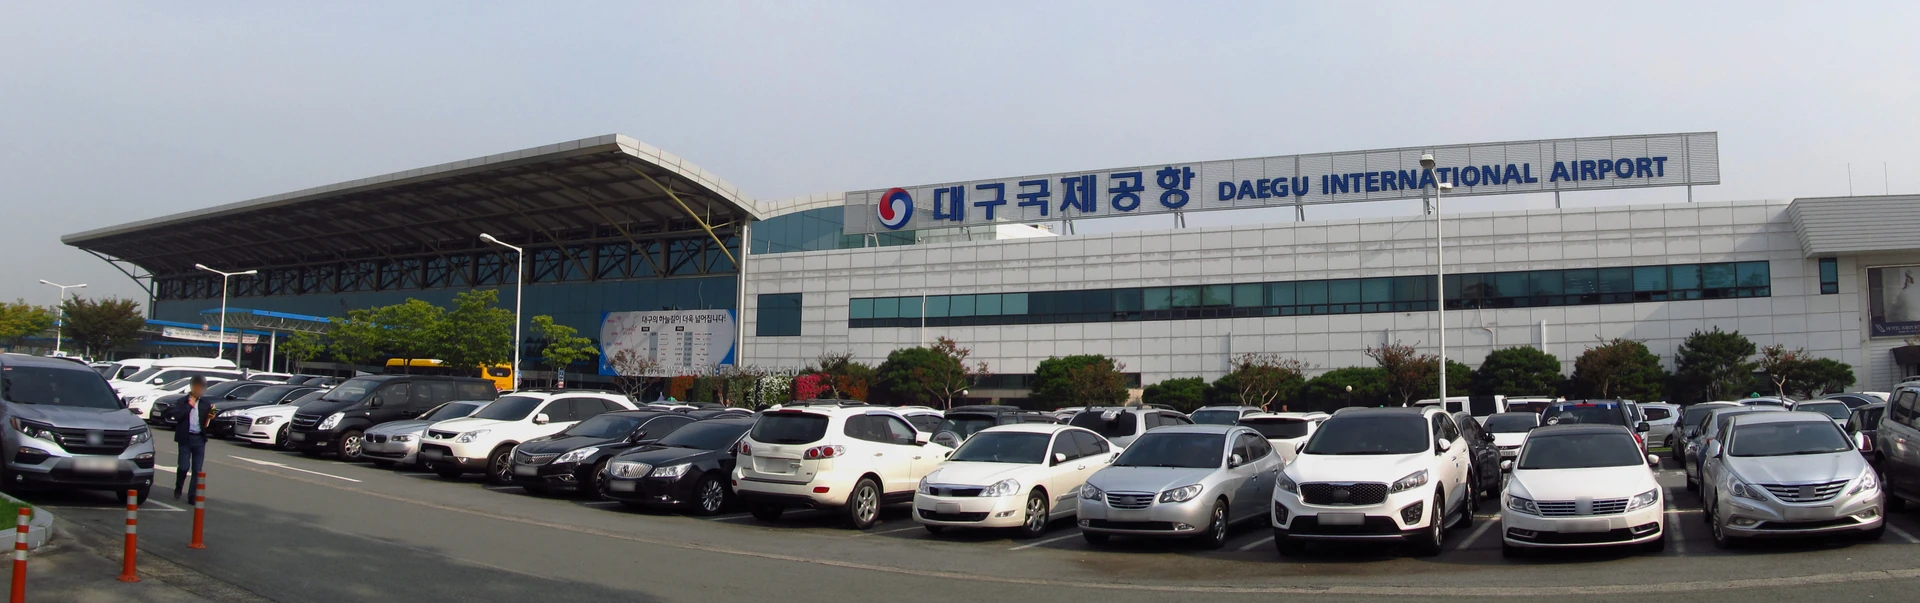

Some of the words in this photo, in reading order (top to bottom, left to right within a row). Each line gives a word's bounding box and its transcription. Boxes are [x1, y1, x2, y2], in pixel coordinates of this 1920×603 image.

[933, 166, 1195, 221] 대구국제공항
[1218, 176, 1309, 201] DAEGU
[1322, 163, 1538, 194] INTERNATIONAL
[1550, 156, 1668, 183] AIRPORT
[642, 316, 658, 325] 대구의
[659, 315, 682, 325] 하늘길이
[683, 315, 694, 324] 더욱
